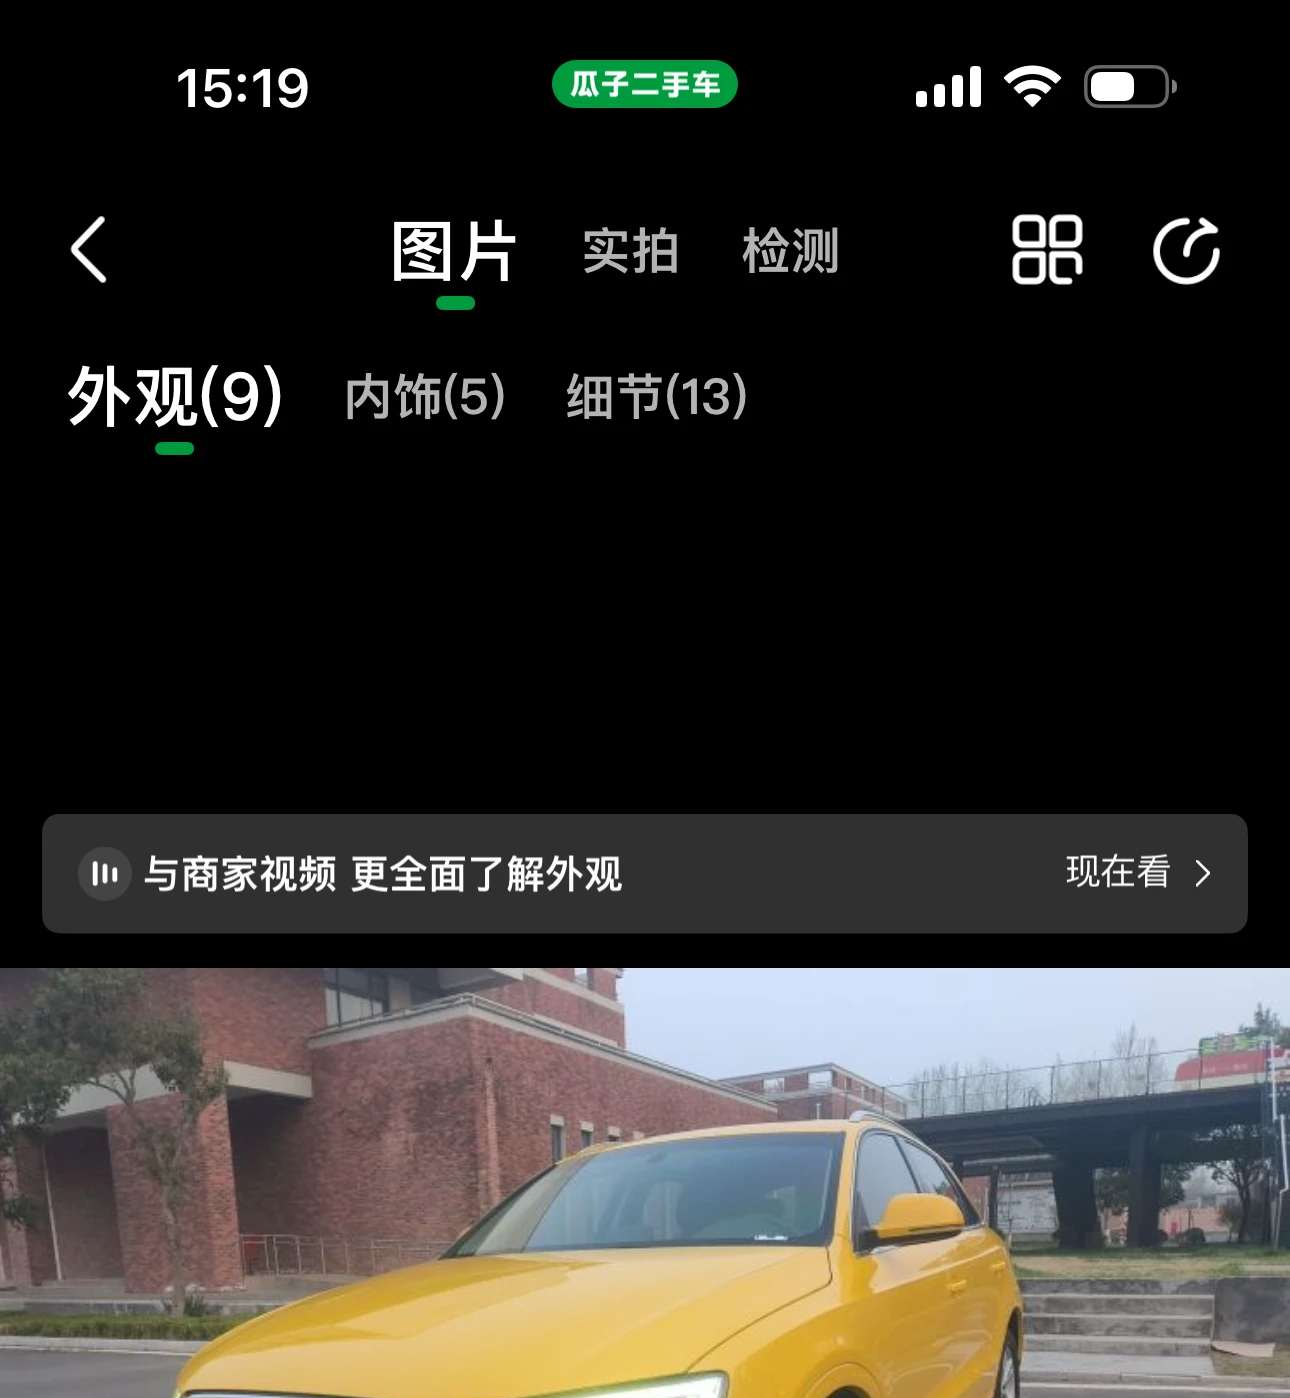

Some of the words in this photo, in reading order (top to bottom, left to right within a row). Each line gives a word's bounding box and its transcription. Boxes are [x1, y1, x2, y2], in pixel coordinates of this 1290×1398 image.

[177, 67, 309, 109] 15:19
[570, 70, 721, 99] 瓜子二手车
[393, 219, 517, 282] 图片
[583, 226, 679, 274] 实拍
[742, 226, 838, 274] 检测
[67, 364, 281, 428] 外观(9)
[346, 372, 505, 420] 内饰(5)
[566, 372, 747, 420] 细节(13)
[143, 854, 336, 893] 与商家视频
[351, 854, 623, 893] 更全面了解外观
[1066, 853, 1171, 889] 现在看
